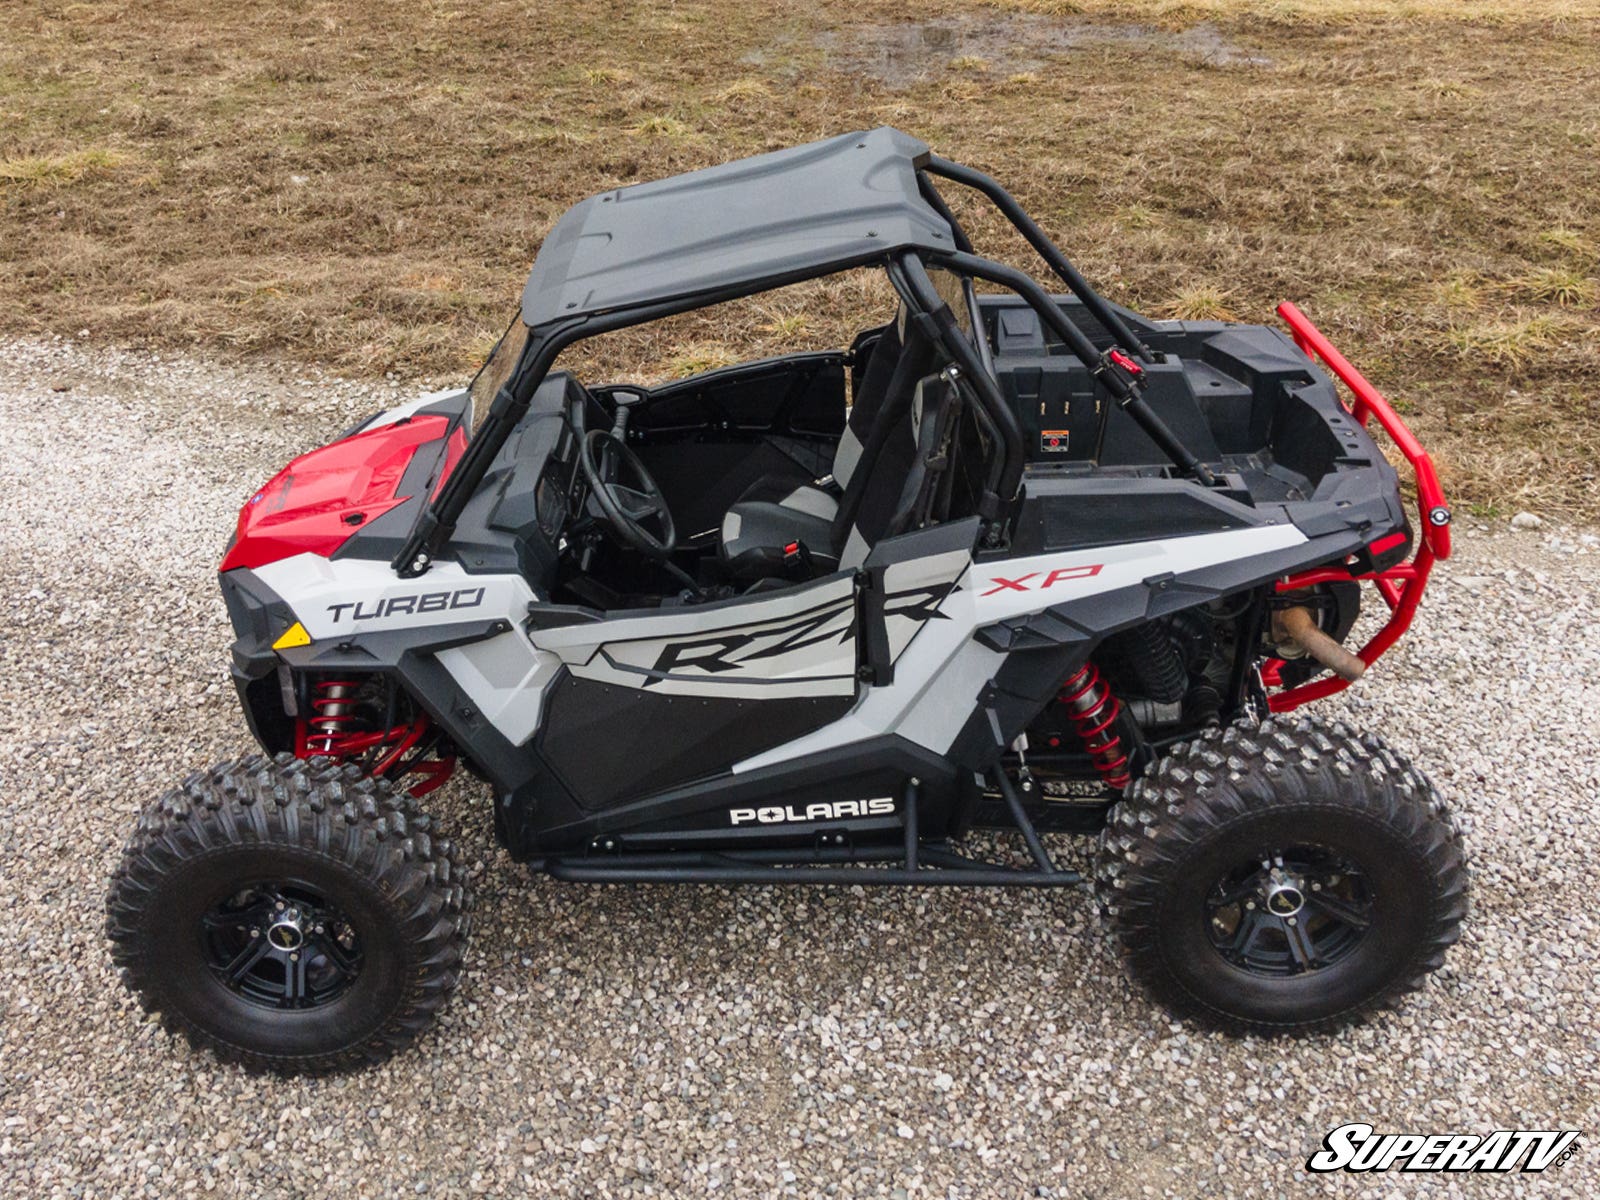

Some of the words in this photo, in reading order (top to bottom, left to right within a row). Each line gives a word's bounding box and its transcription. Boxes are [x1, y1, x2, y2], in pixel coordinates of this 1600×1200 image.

[978, 564, 1105, 597] XP
[327, 587, 486, 623] TURBO
[641, 582, 963, 688] RZR
[729, 797, 896, 825] POLARIS
